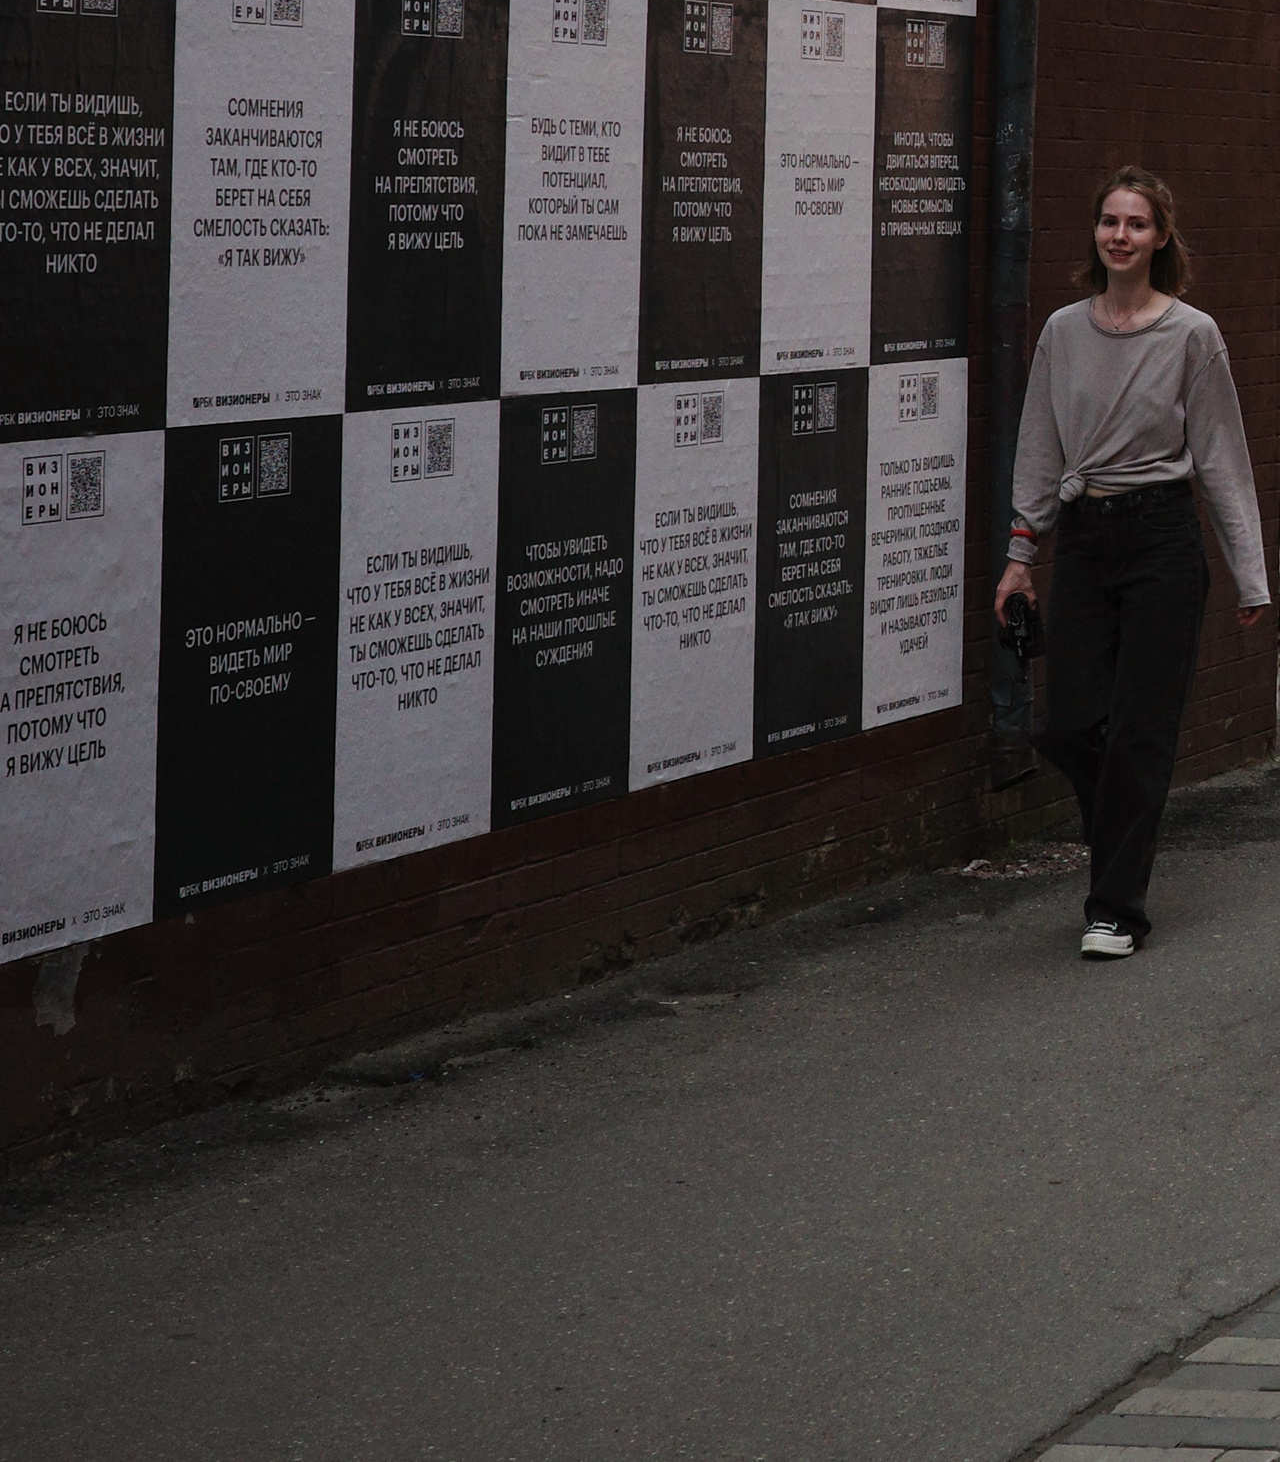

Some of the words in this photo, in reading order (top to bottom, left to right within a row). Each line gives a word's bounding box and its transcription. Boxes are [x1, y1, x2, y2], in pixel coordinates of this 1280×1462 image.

[531, 117, 557, 137] БУДЬ
[559, 118, 567, 135] С
[568, 119, 599, 138] ТЕМИ,
[601, 121, 621, 138] КТО
[541, 144, 577, 164] ВИДИТ
[578, 146, 585, 162] В
[586, 146, 610, 163] ТЕБЕ
[780, 152, 798, 168] ЭТО
[798, 153, 851, 170] НОРМАЛЬНО
[541, 171, 608, 191] ПОТЕНЦИАЛ,
[794, 177, 826, 194] ВИДЕТЬ
[827, 177, 845, 192] МИР
[528, 195, 579, 215] КОТОРЫЙ
[580, 198, 595, 215] ТЫ
[596, 198, 619, 215] САМ
[794, 200, 844, 216] ПО-СВОЕМУ
[517, 224, 548, 241] ПОКА
[550, 224, 564, 241] НЕ
[565, 224, 628, 241] ЗАМЕЧАЕШЬ
[197, 396, 213, 408] РБК
[215, 392, 271, 408] ВИЗИОНЕРЫ
[285, 390, 300, 402] ЭТО
[302, 389, 322, 401] ЗНАК
[366, 552, 399, 575] ЕСЛИ
[401, 550, 418, 569] ТЫ
[420, 543, 473, 567] ВИДИШЬ,
[346, 585, 372, 605] ЧТО
[373, 583, 381, 602] У
[383, 579, 412, 600] ТЕБЯ
[414, 571, 436, 596] ВСЁ
[438, 574, 446, 592] В
[448, 566, 490, 590] ЖИЗНИ
[349, 614, 366, 634] НЕ
[368, 610, 392, 631] КАК
[394, 609, 402, 627] У
[404, 603, 437, 625] ВСЕХ,
[439, 595, 485, 619] ЗНАЧИТ,
[349, 643, 366, 663] ТЫ
[369, 632, 433, 660] СМОЖЕШЬ
[435, 623, 485, 649] СДЕЛАТЬ
[351, 666, 398, 691] ЧТО-ТО,
[400, 661, 425, 681] ЧТО
[427, 657, 442, 677] НЕ
[443, 650, 481, 676] ДЕЛАЛ
[398, 686, 438, 712] НИКТО
[185, 883, 200, 896] РБК
[202, 867, 258, 893] ВИЗИОНЕРЫ
[273, 859, 289, 874] ЭТО
[290, 855, 309, 869] ЗНАК
